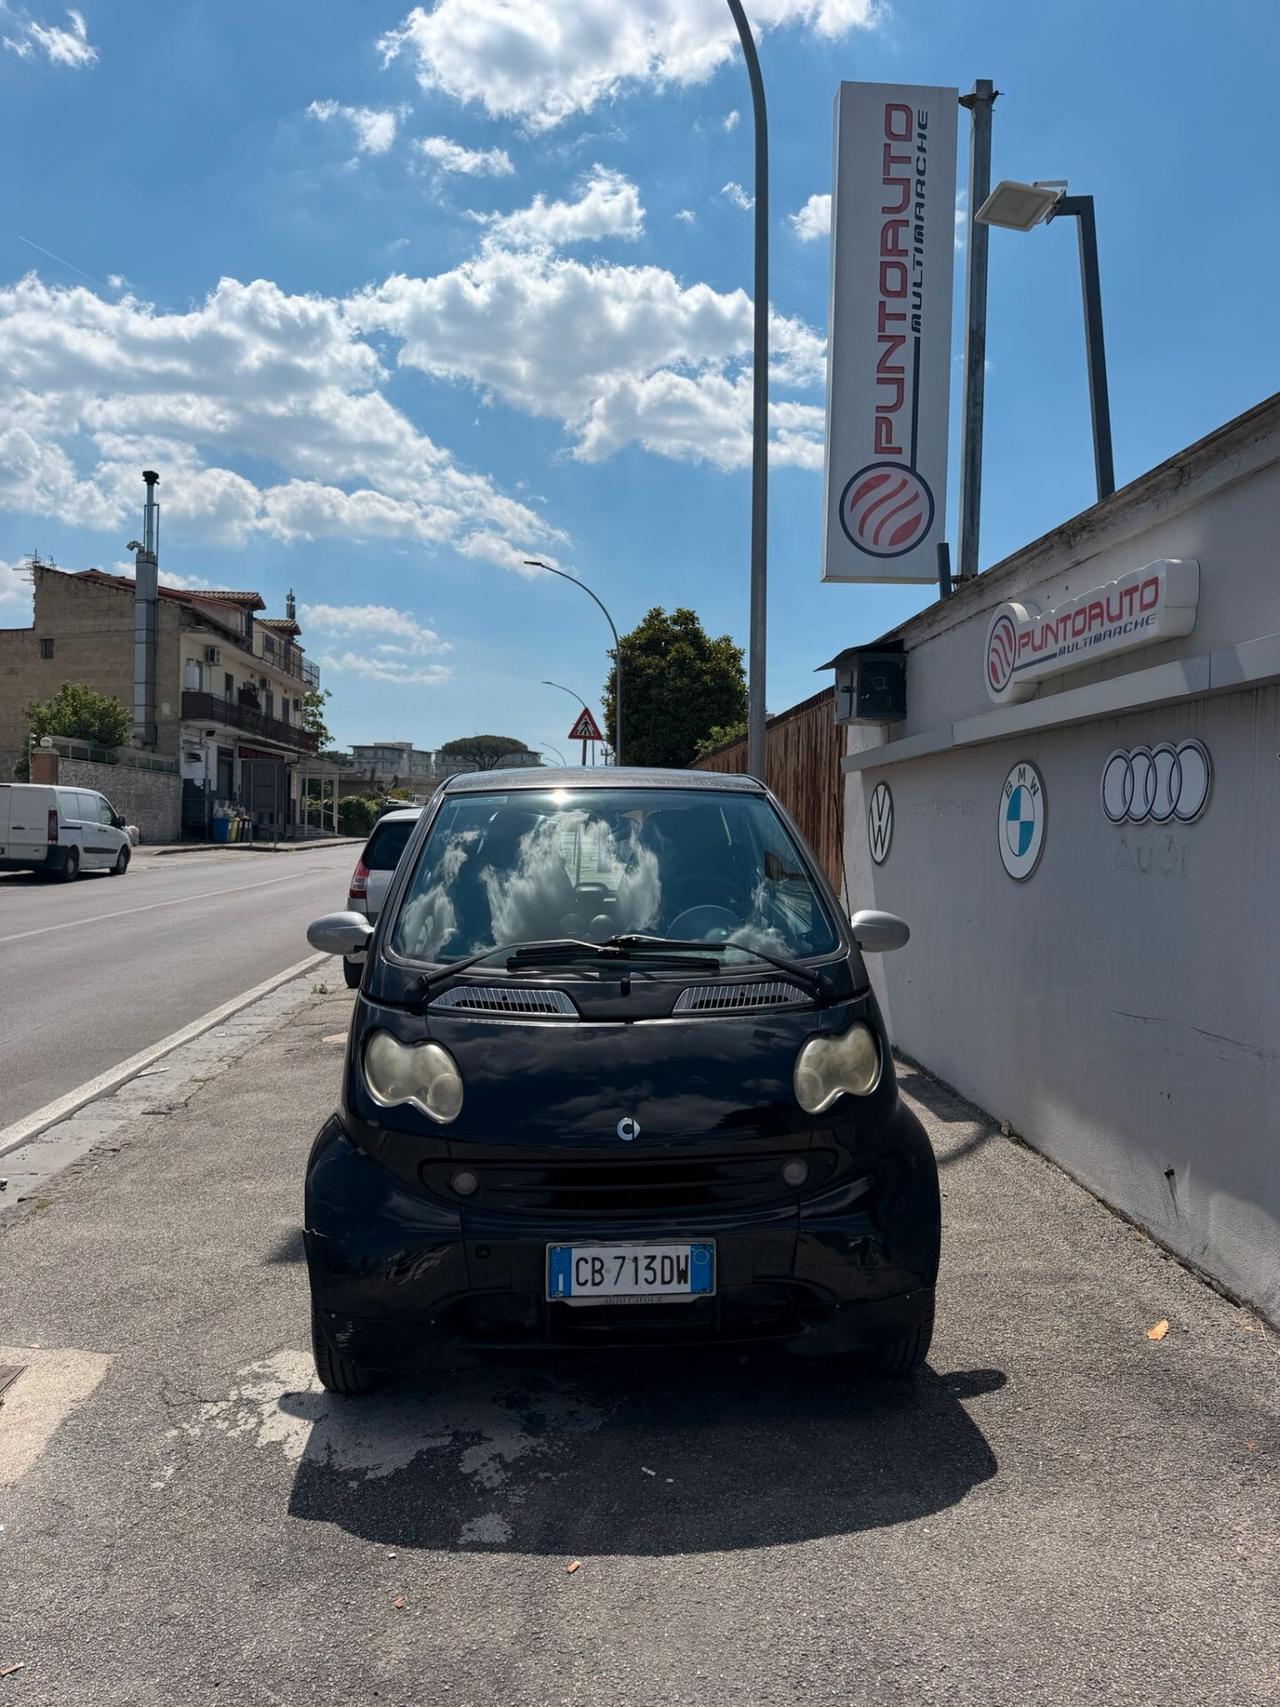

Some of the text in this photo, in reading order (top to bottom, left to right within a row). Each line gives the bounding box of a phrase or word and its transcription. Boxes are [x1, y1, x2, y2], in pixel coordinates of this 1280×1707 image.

[911, 108, 928, 334] MULTIMARCHE
[873, 102, 914, 455] PUNTOAUTO
[1017, 576, 1159, 658] PUNTOAUTO
[1057, 613, 1156, 657] MULTIMARCHE
[1004, 767, 1040, 800] BMW
